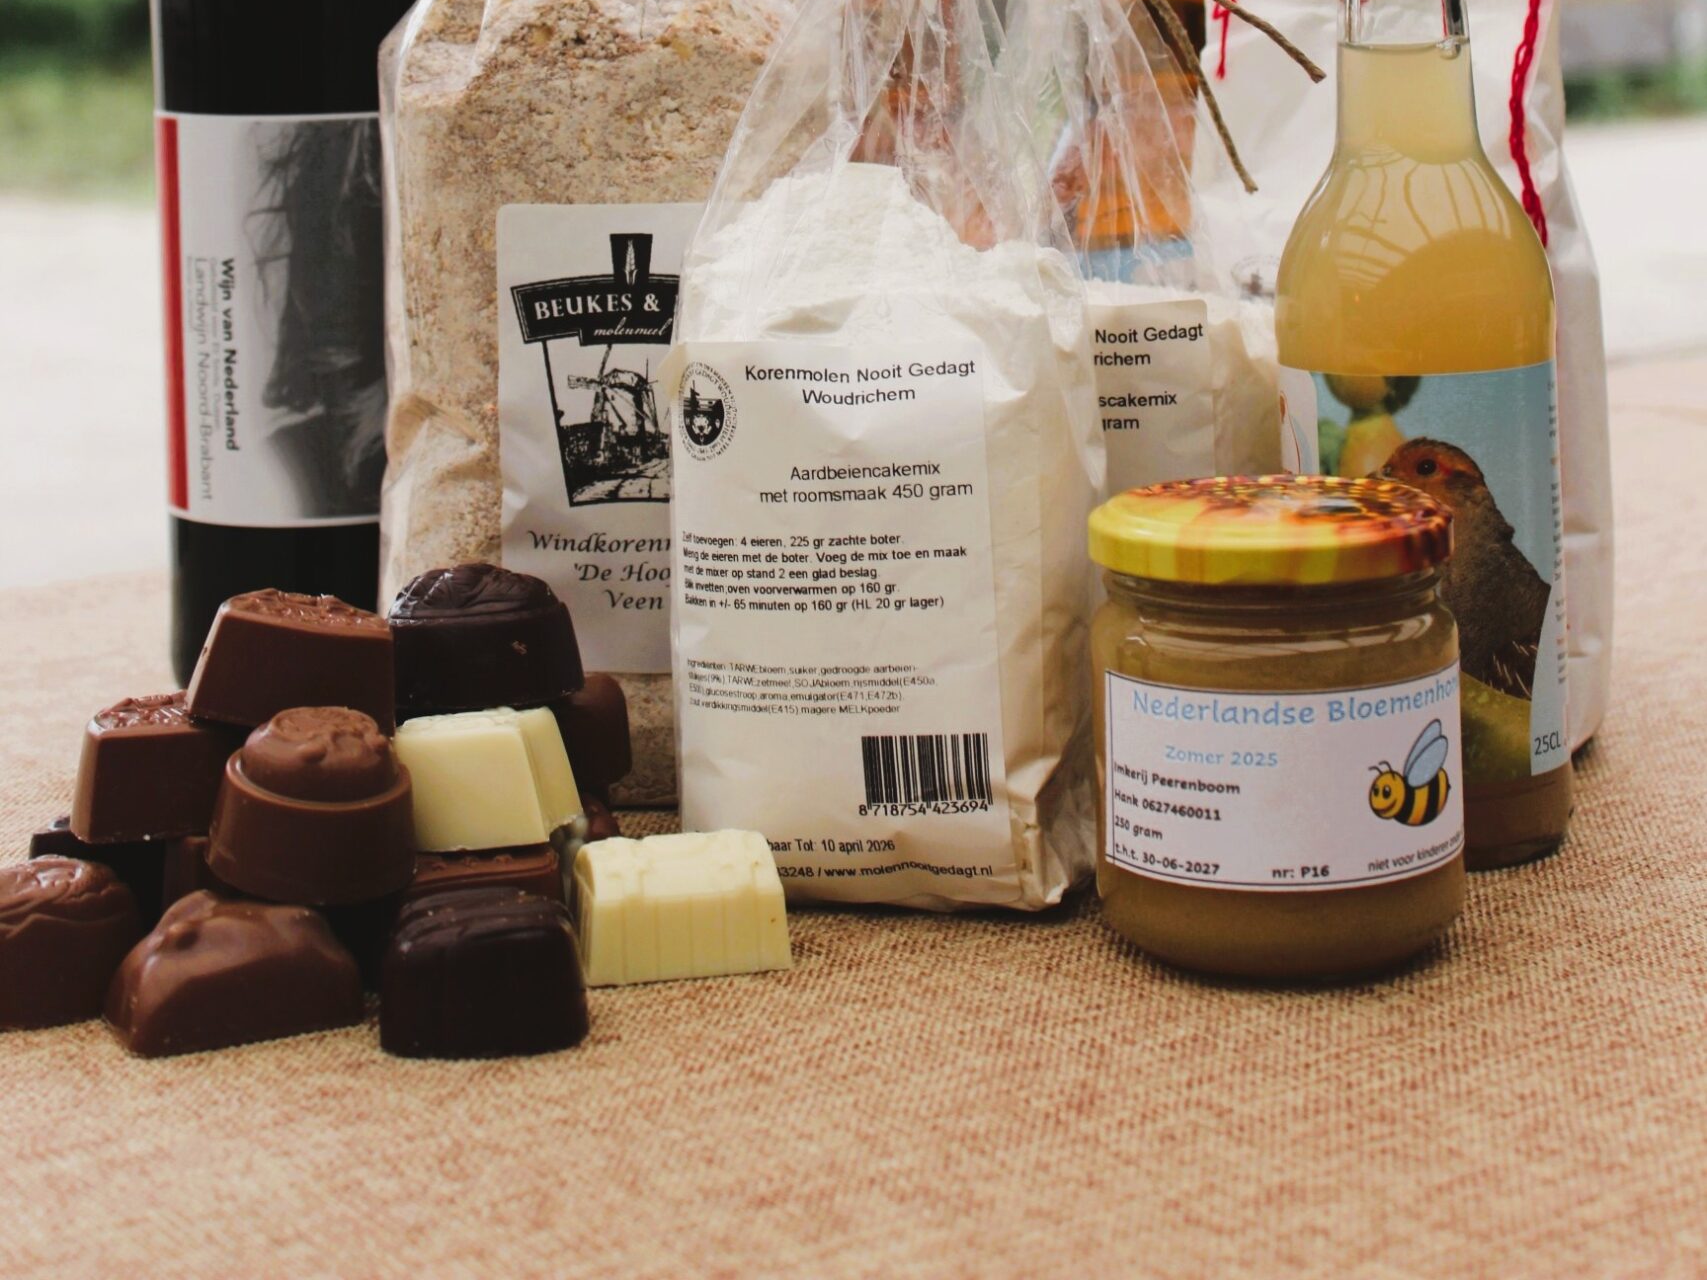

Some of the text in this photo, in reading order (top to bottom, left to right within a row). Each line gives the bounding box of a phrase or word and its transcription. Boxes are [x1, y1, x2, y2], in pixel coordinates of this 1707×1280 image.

[194, 258, 209, 344] Landwijn
[534, 293, 660, 320] BEUKES &
[593, 316, 672, 336] molenmeel
[1095, 323, 1204, 344] Nooit Gedagt
[219, 257, 239, 451] Wijn van Nederland
[745, 360, 976, 383] Korenmolen Nooit Gedagt
[802, 389, 916, 406] Woudrichem
[1098, 391, 1178, 408] scakemix
[790, 460, 941, 481] Aardbeiencakemix
[760, 483, 973, 503] met roomsmaak 450 gram
[740, 537, 747, 546] 4
[790, 536, 809, 547] 225
[813, 537, 825, 549] gr
[828, 535, 867, 546] zachte
[683, 547, 699, 561] Meng
[700, 550, 709, 561] de
[711, 552, 739, 563] eieren
[742, 552, 761, 563] met
[765, 552, 778, 563] de
[816, 552, 847, 564] Voeg
[851, 551, 864, 562] de
[868, 550, 888, 561] mix
[892, 549, 911, 560] toe
[915, 549, 930, 558] en
[934, 546, 967, 558] maak
[696, 566, 704, 575] de
[706, 568, 729, 578] mixer
[732, 570, 744, 582] op
[747, 568, 776, 579] stand
[779, 568, 785, 579] 2
[789, 570, 808, 579] een
[812, 568, 836, 582] glad
[605, 589, 664, 610] Veen
[753, 585, 837, 596] voorverwarmen
[841, 584, 856, 595] op
[860, 582, 881, 594] 160
[685, 593, 707, 607] Bakken
[709, 597, 716, 607] in
[734, 599, 746, 610] 65
[749, 600, 791, 611] minuten
[794, 601, 808, 612] op
[811, 600, 832, 611] 160
[836, 601, 848, 613] gr
[852, 598, 872, 612] (HL
[875, 598, 890, 609] 20
[894, 599, 906, 611] gr
[910, 596, 945, 609] lager)
[1132, 689, 1315, 726] Nederlandse
[1165, 745, 1279, 768] Zomer 2025
[1114, 763, 1241, 795] Imkerij Peerenboom
[858, 800, 989, 817] 8 718754 423694
[1114, 789, 1222, 821] Hank 0627460011
[1114, 815, 1163, 840] 250 gram
[821, 839, 836, 852] 10
[838, 838, 863, 855] april
[866, 839, 895, 853] 2026
[1114, 843, 1330, 880] t.h.t. 30-06-2027 nr: P16
[1367, 858, 1391, 874] niet
[1392, 851, 1416, 868] voor
